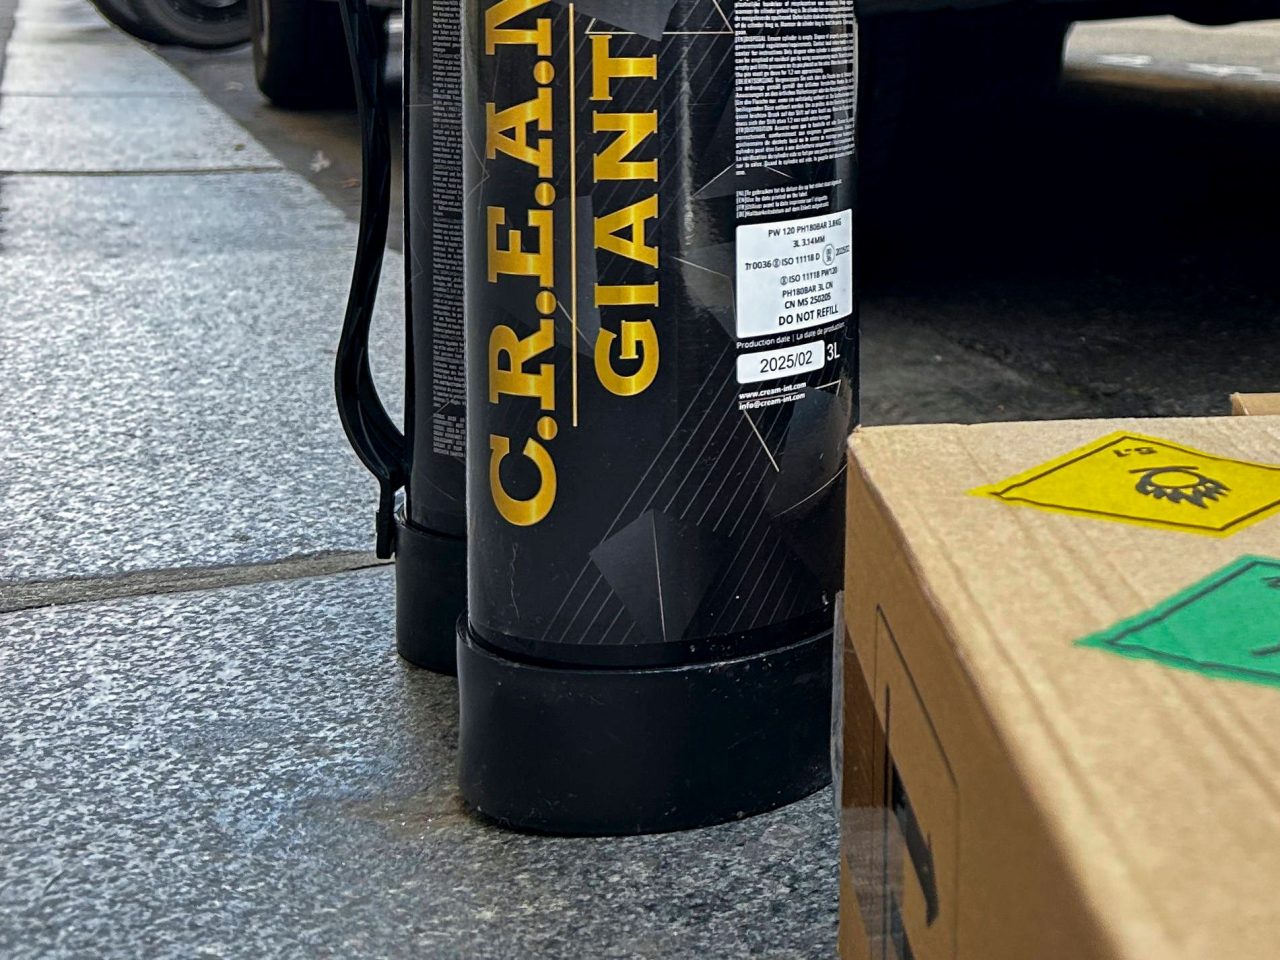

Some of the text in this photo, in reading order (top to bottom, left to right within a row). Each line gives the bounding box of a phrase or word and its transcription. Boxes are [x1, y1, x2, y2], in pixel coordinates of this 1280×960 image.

[589, 33, 660, 397] GIANT
[768, 229, 781, 237] PW
[783, 227, 795, 235] 120
[793, 240, 801, 248] 3L
[781, 257, 794, 266] ISO
[789, 274, 801, 283] ISO
[784, 300, 796, 309] CN
[797, 297, 809, 307] MS
[778, 304, 839, 326] DO NOT REFILL
[736, 337, 775, 349] Production
[776, 334, 791, 343] date
[760, 341, 840, 374] 2025/02 3L
[738, 382, 807, 400] www.cream-int.com
[739, 393, 806, 411] info@cream-int.com
